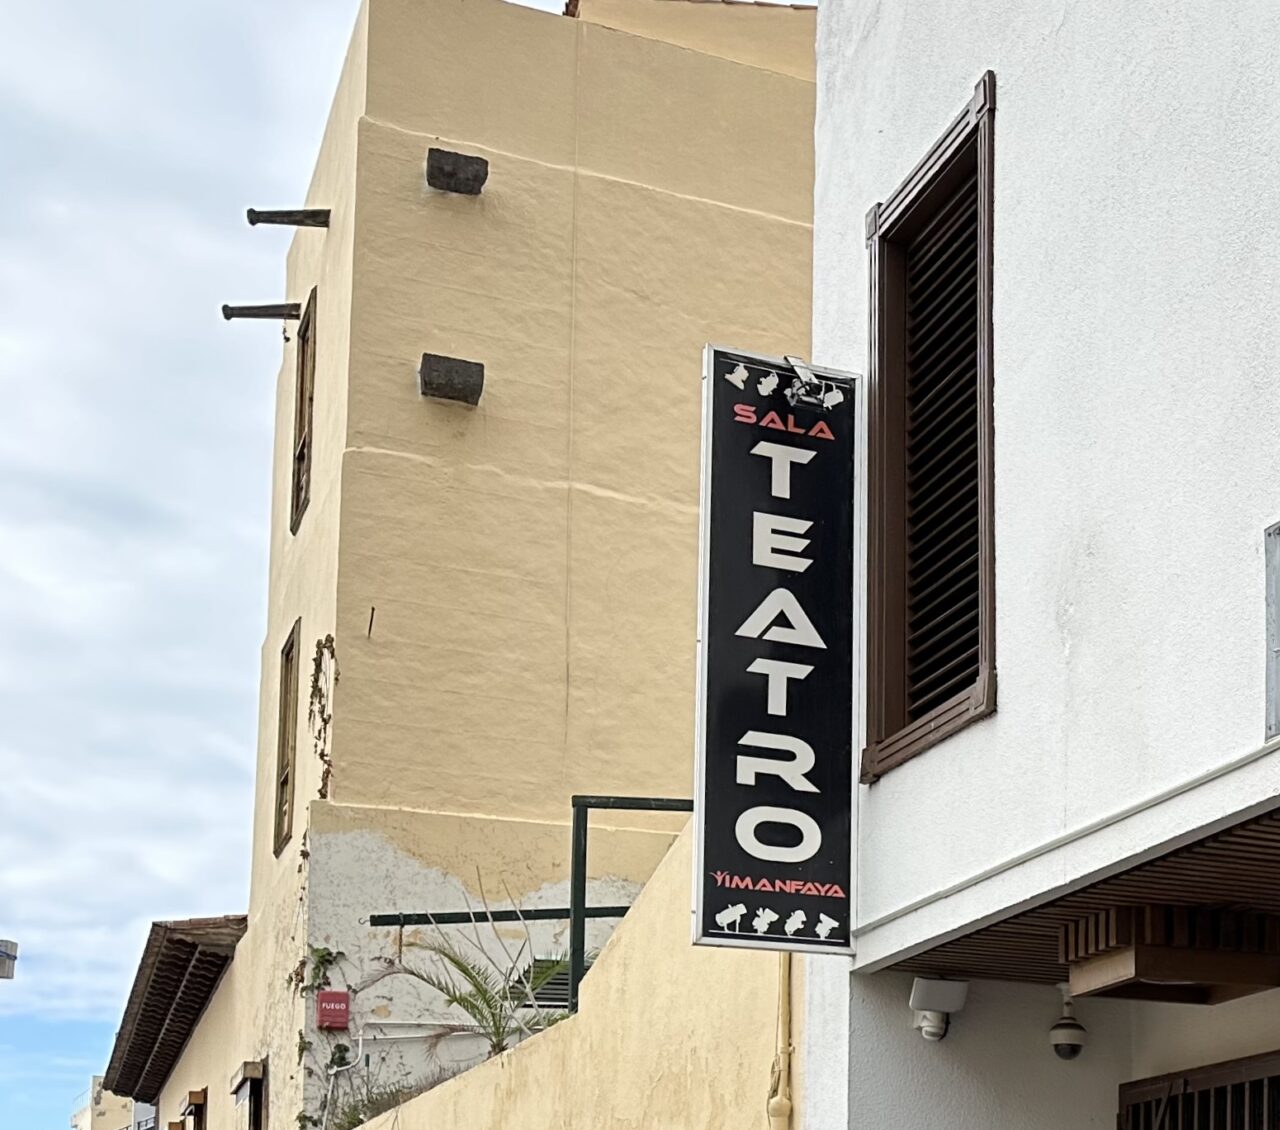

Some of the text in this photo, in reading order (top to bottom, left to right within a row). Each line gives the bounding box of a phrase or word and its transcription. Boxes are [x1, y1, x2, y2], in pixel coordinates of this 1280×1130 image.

[733, 403, 835, 440] SALA
[734, 440, 828, 863] TEATRO
[322, 1002, 346, 1010] FUEGO
